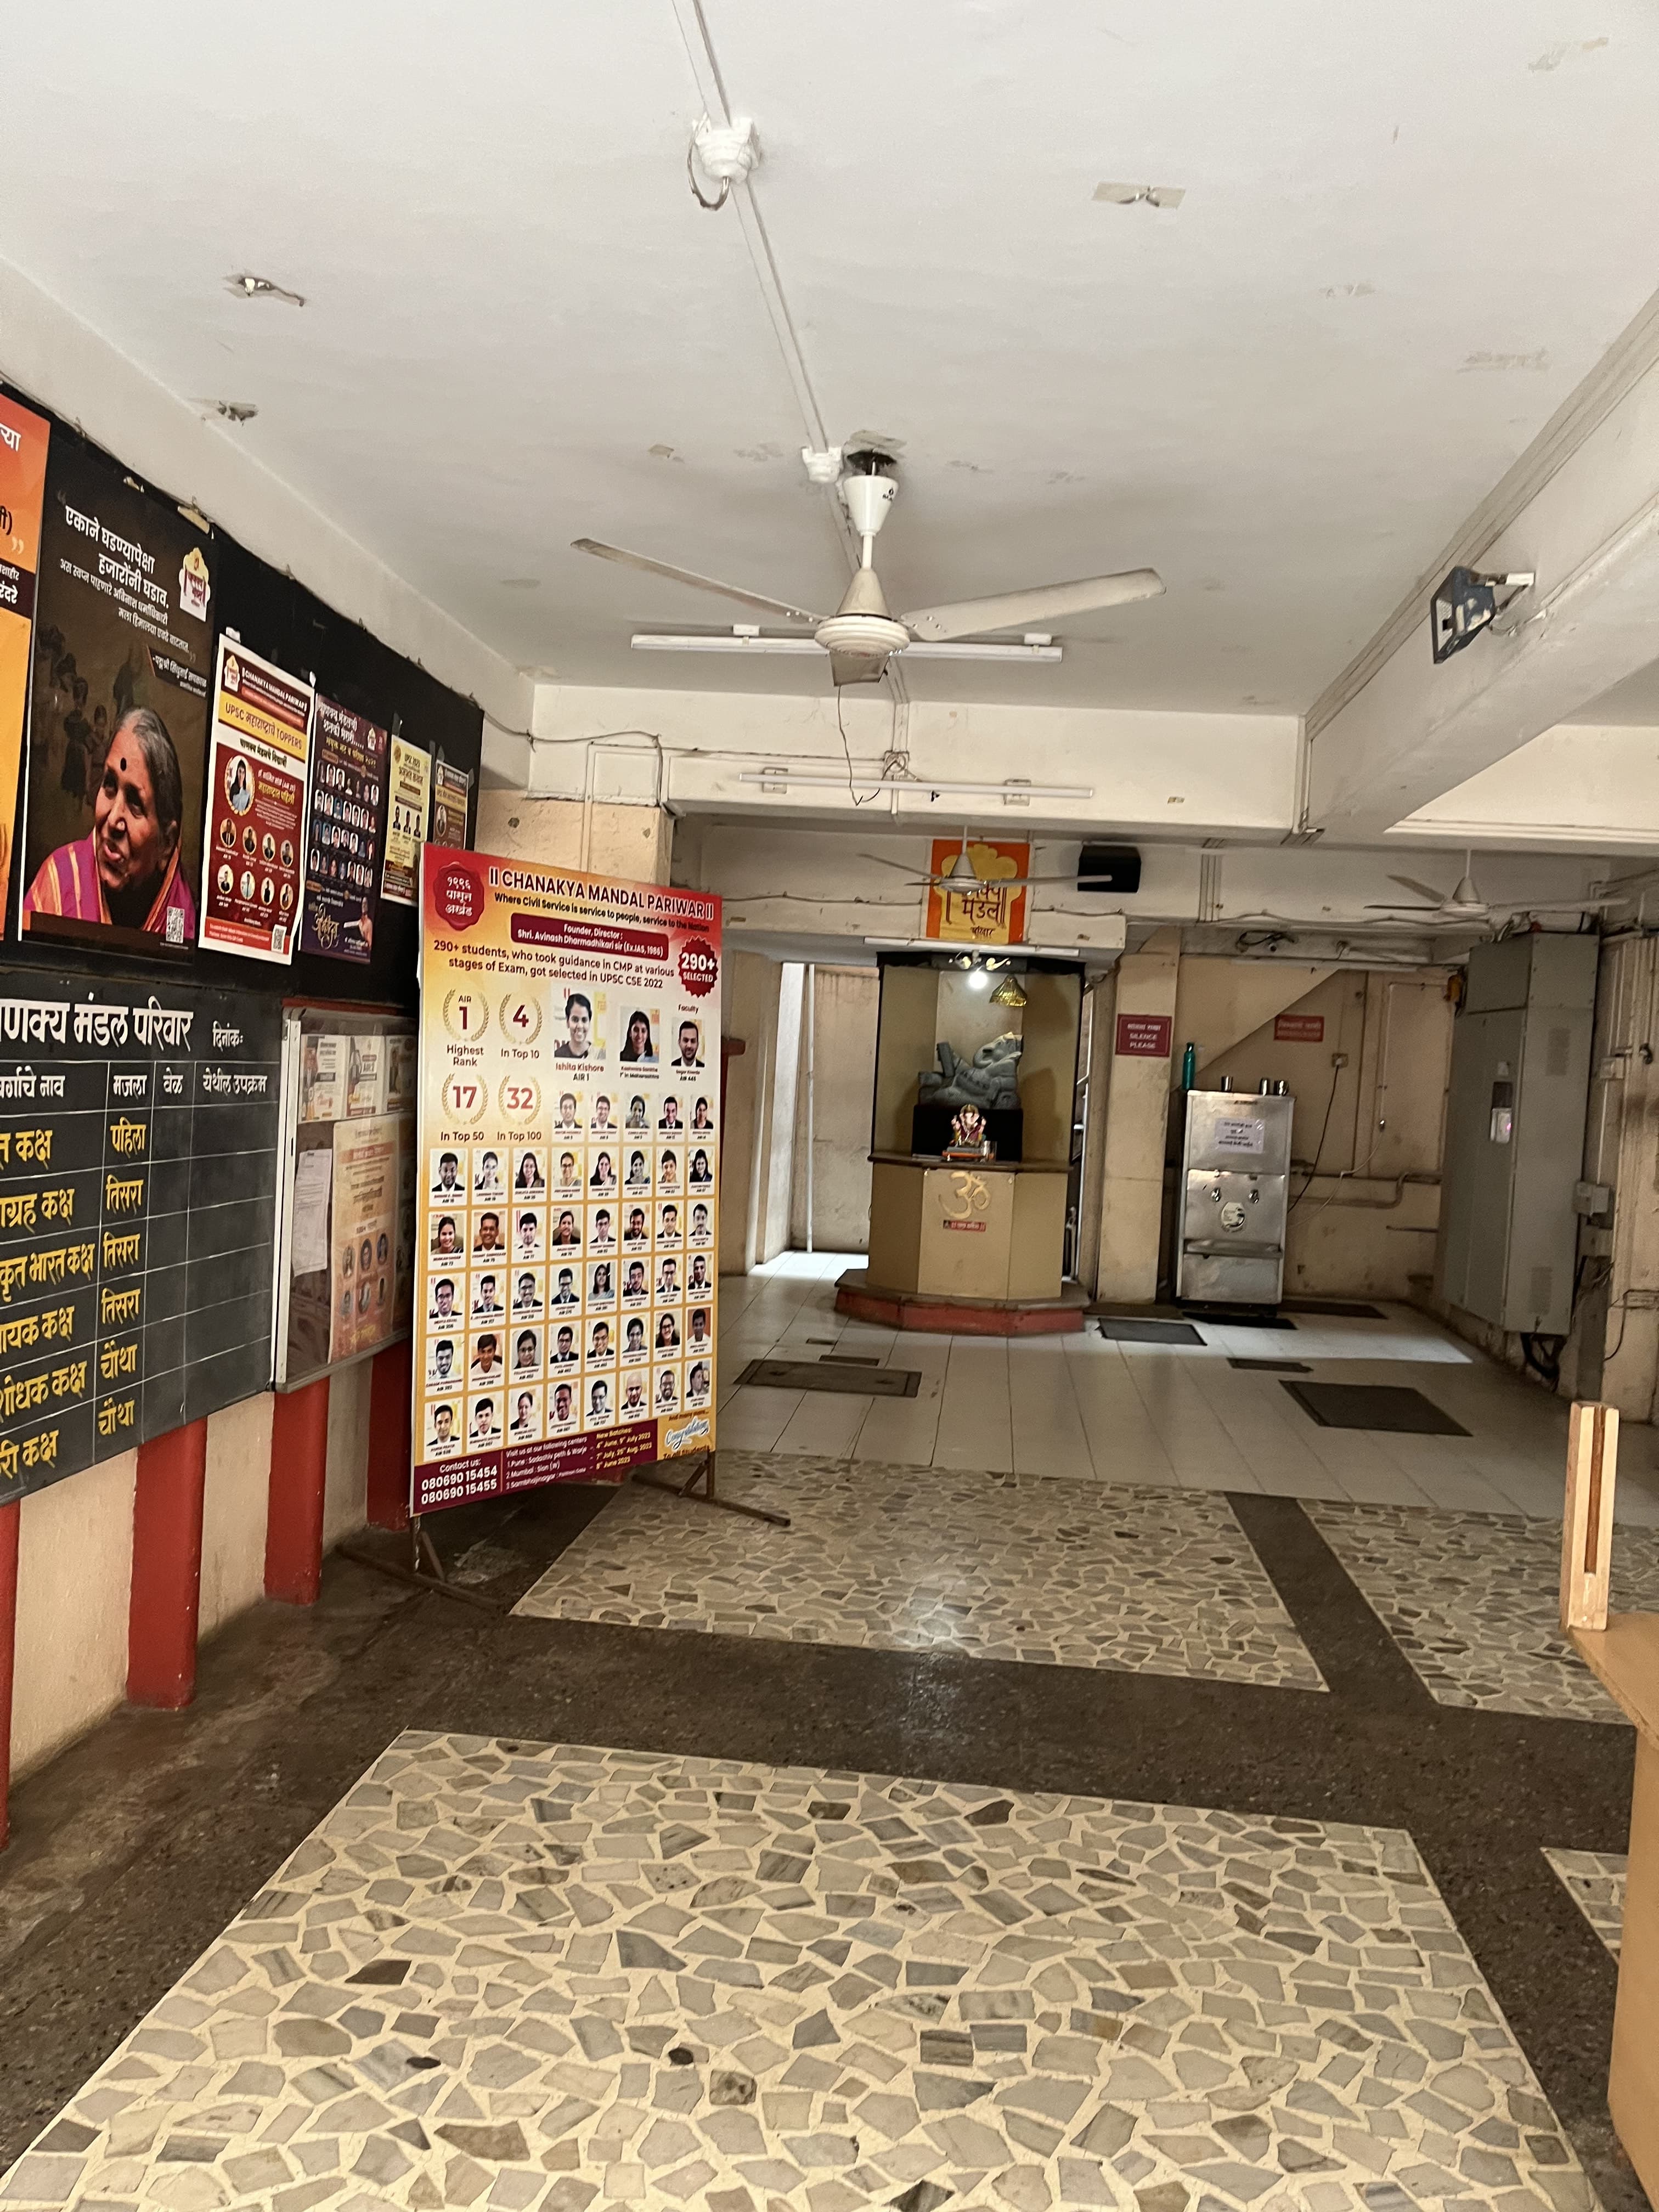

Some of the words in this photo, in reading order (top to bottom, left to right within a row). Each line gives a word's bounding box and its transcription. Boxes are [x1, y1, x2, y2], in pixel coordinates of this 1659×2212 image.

[65, 505, 100, 541] एकाने
[101, 527, 155, 574] घडण्यापेक्षा
[99, 553, 142, 592] हजारोंनी
[225, 702, 244, 720] UPSC
[277, 728, 302, 750] TOPPERS
[502, 870, 585, 899] CHANAKYA
[588, 884, 645, 908] MANDAL
[647, 895, 703, 918] PARIWAR
[495, 893, 522, 905] Where
[523, 898, 540, 906] Civil
[542, 900, 570, 912] Service
[572, 905, 578, 913] is
[579, 907, 606, 917] service
[607, 911, 614, 919] to
[616, 912, 642, 924] people,
[643, 916, 668, 927] service
[676, 921, 687, 929] the
[534, 933, 563, 943] Avinash
[563, 935, 614, 949] Dharmadhikari
[564, 923, 593, 936] Founder,
[434, 940, 459, 951] 290+
[462, 945, 509, 960] students,
[512, 950, 532, 961] who
[535, 952, 556, 963] took
[559, 956, 600, 968] guidance
[603, 959, 611, 969] in
[613, 961, 632, 972] CMP
[635, 964, 643, 973] at
[645, 965, 674, 977] various
[681, 952, 715, 971] 290+
[449, 958, 483, 971] stages
[486, 960, 495, 970] of
[498, 962, 528, 976] Exam,
[531, 967, 546, 978] got
[549, 968, 586, 980] selected
[589, 971, 597, 981] in
[600, 973, 623, 985] UPSC
[626, 978, 642, 986] CSE
[645, 979, 663, 988] 2022
[682, 972, 713, 983] SELECTED
[0, 997, 70, 1043] णक्य
[74, 991, 129, 1048] मंडल
[133, 995, 194, 1052] परिवार
[459, 1006, 467, 1030] 1
[513, 1005, 529, 1028] 4
[678, 1004, 699, 1014] Faculty
[447, 1044, 484, 1057] Highest
[453, 1057, 478, 1066] Rank
[501, 1048, 509, 1058] In
[512, 1049, 528, 1060] Top
[531, 1049, 539, 1059] 10
[555, 1062, 576, 1071] Ishita
[578, 1063, 604, 1072] Kishore
[573, 1073, 585, 1081] AIR
[40, 1075, 65, 1098] नाव
[113, 1074, 147, 1099] मजला
[163, 1066, 183, 1096] वेळ
[203, 1066, 232, 1093] येथील
[233, 1075, 267, 1096] उपक्रम
[453, 1086, 477, 1109] 17
[507, 1087, 533, 1110] 32
[15, 1129, 53, 1170] कक्ष
[110, 1116, 146, 1159] पहिला
[441, 1132, 450, 1141] In
[453, 1132, 470, 1142] Top
[473, 1131, 484, 1141] 50
[497, 1132, 505, 1141] In
[507, 1132, 525, 1143] Top
[527, 1131, 542, 1141] 100
[41, 1188, 75, 1226] कक्ष
[105, 1174, 144, 1216] तिसरा
[29, 1248, 66, 1285] भारत
[67, 1243, 95, 1281] कक्ष
[103, 1231, 140, 1271] तिसरा
[42, 1305, 75, 1342] कक्ष
[101, 1288, 141, 1325] तिसरा
[52, 1361, 88, 1398] कक्ष
[100, 1339, 138, 1380] चौथा
[22, 1429, 59, 1468] कक्ष
[98, 1397, 135, 1436] चौथा
[421, 1472, 464, 1491] 080690
[465, 1465, 498, 1482] 15454
[439, 1459, 469, 1473] Contact
[421, 1485, 464, 1505] 080690
[465, 1478, 497, 1496] 15455
